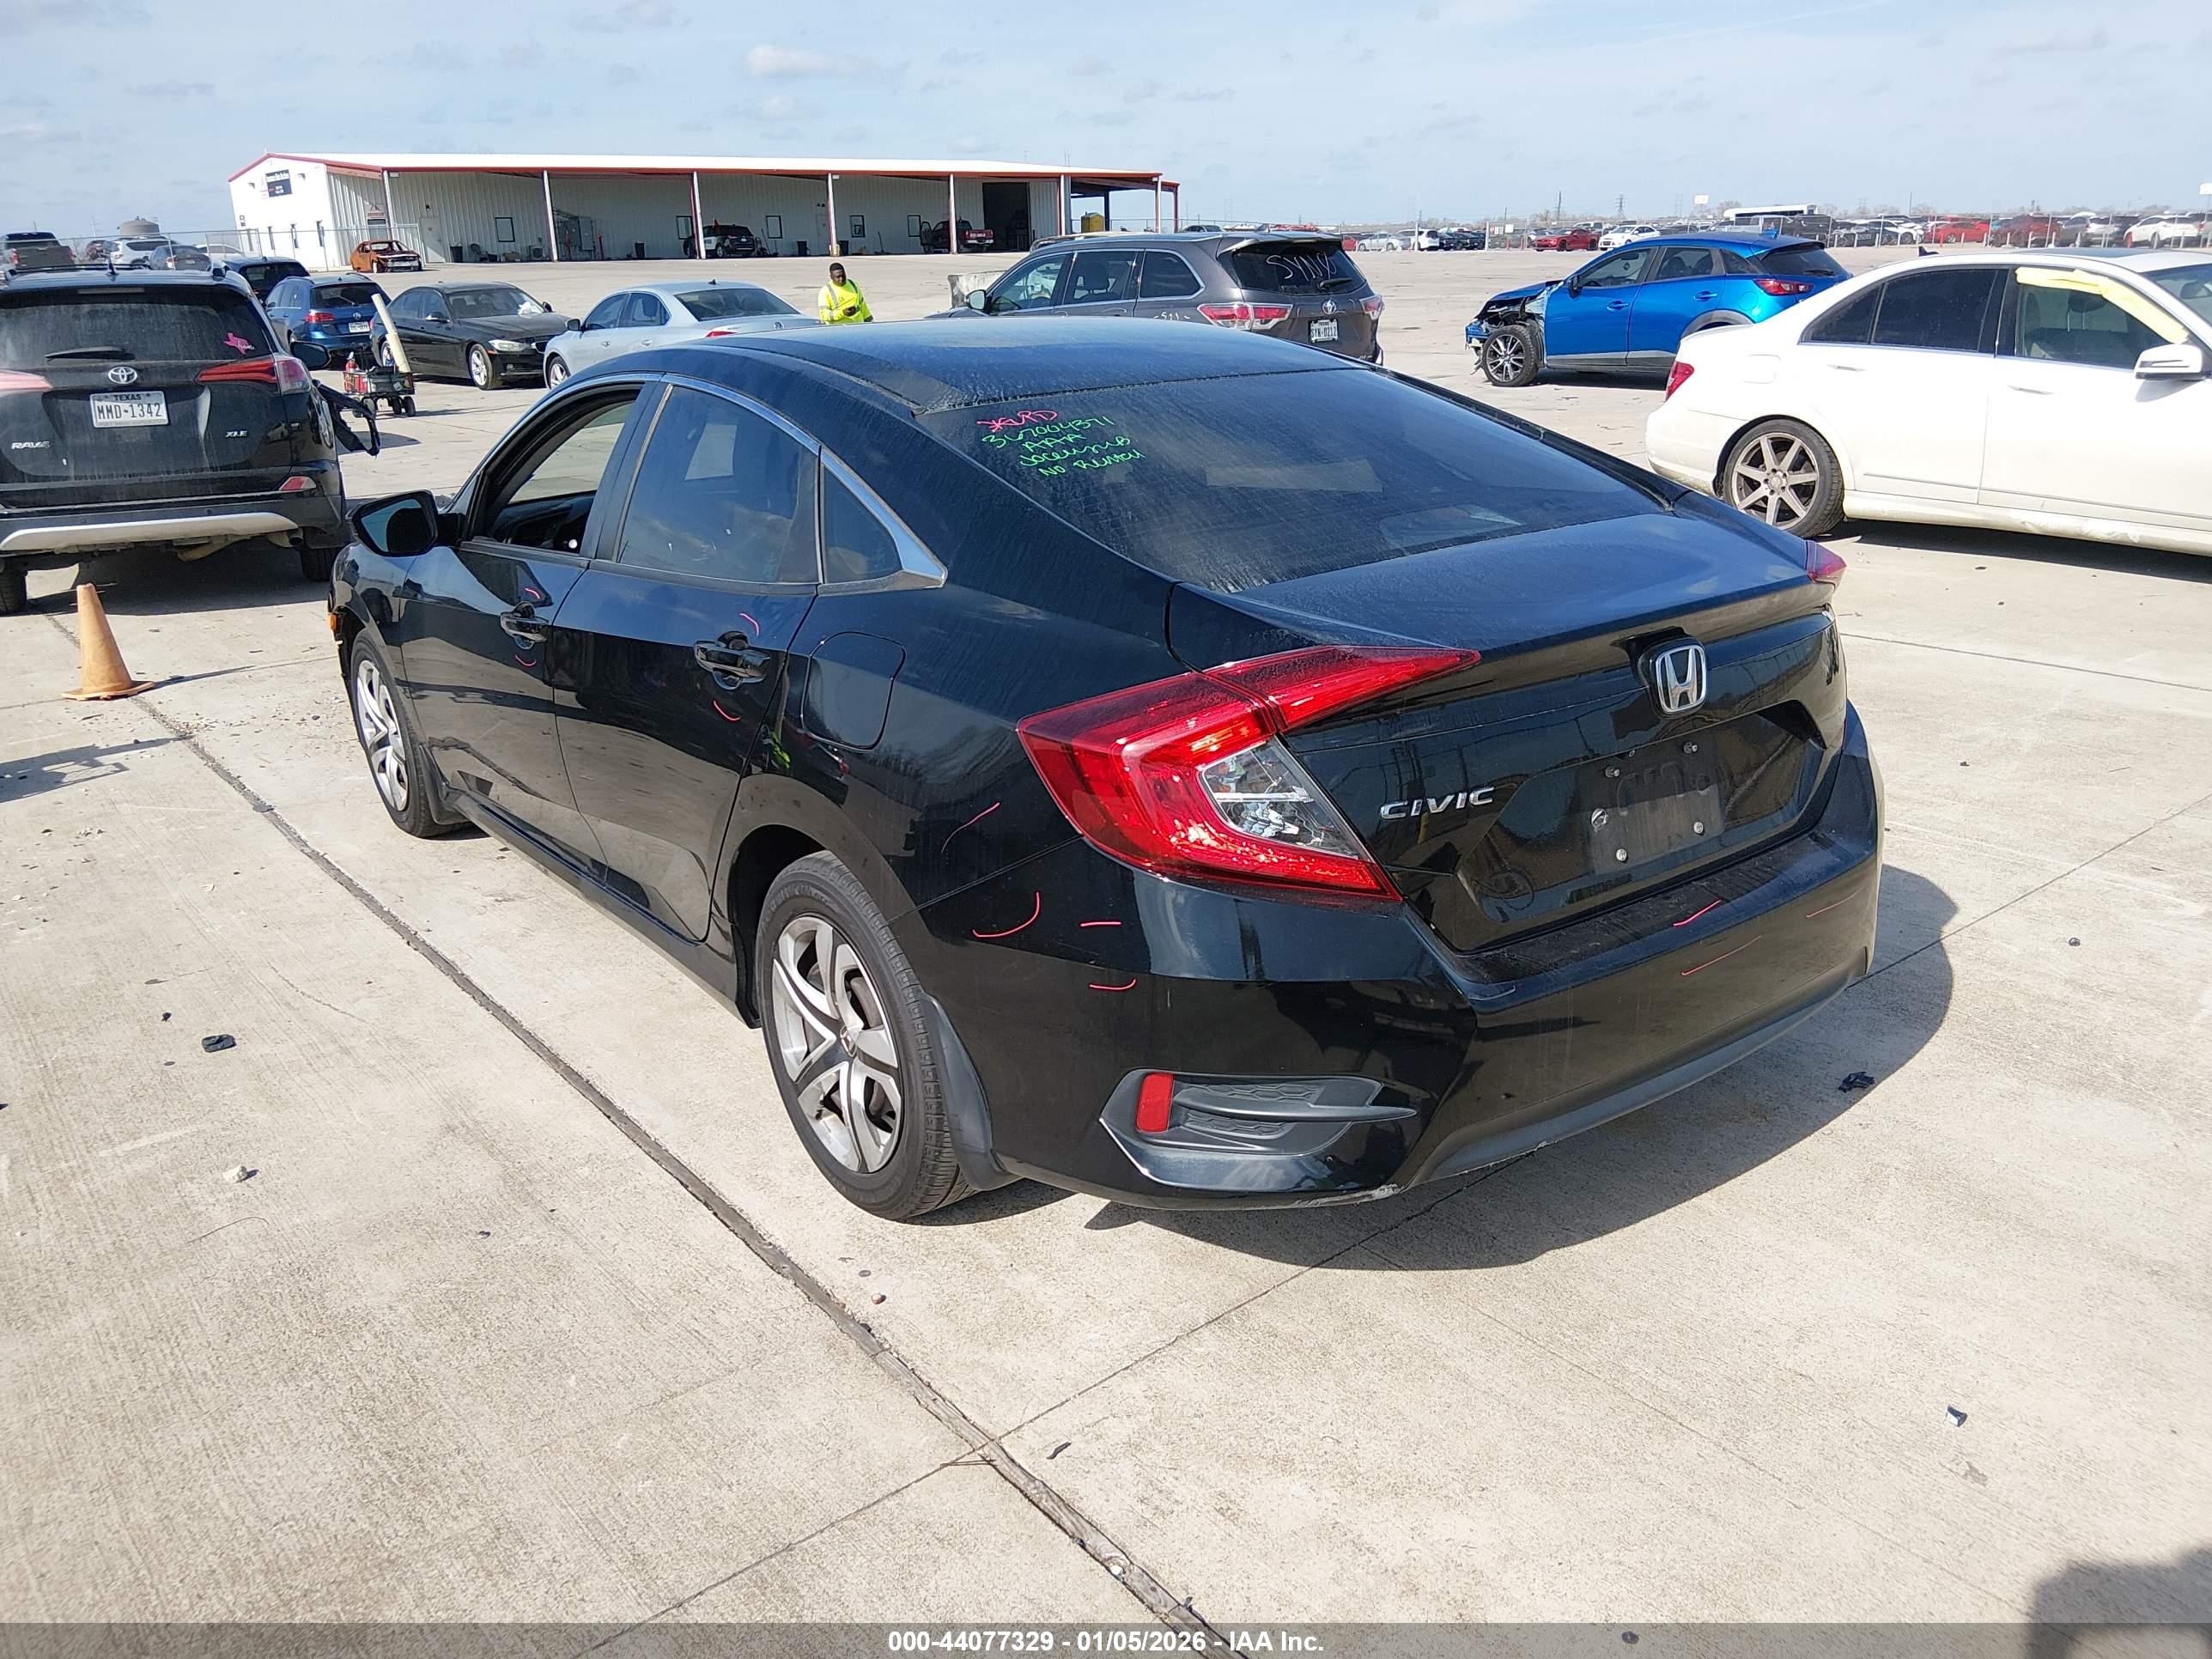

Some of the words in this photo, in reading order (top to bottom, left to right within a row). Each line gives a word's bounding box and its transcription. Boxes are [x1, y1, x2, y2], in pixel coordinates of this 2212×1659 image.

[11, 441, 52, 450] RAV4
[1038, 465, 1066, 477] NO
[1380, 787, 1495, 820] CIVIC
